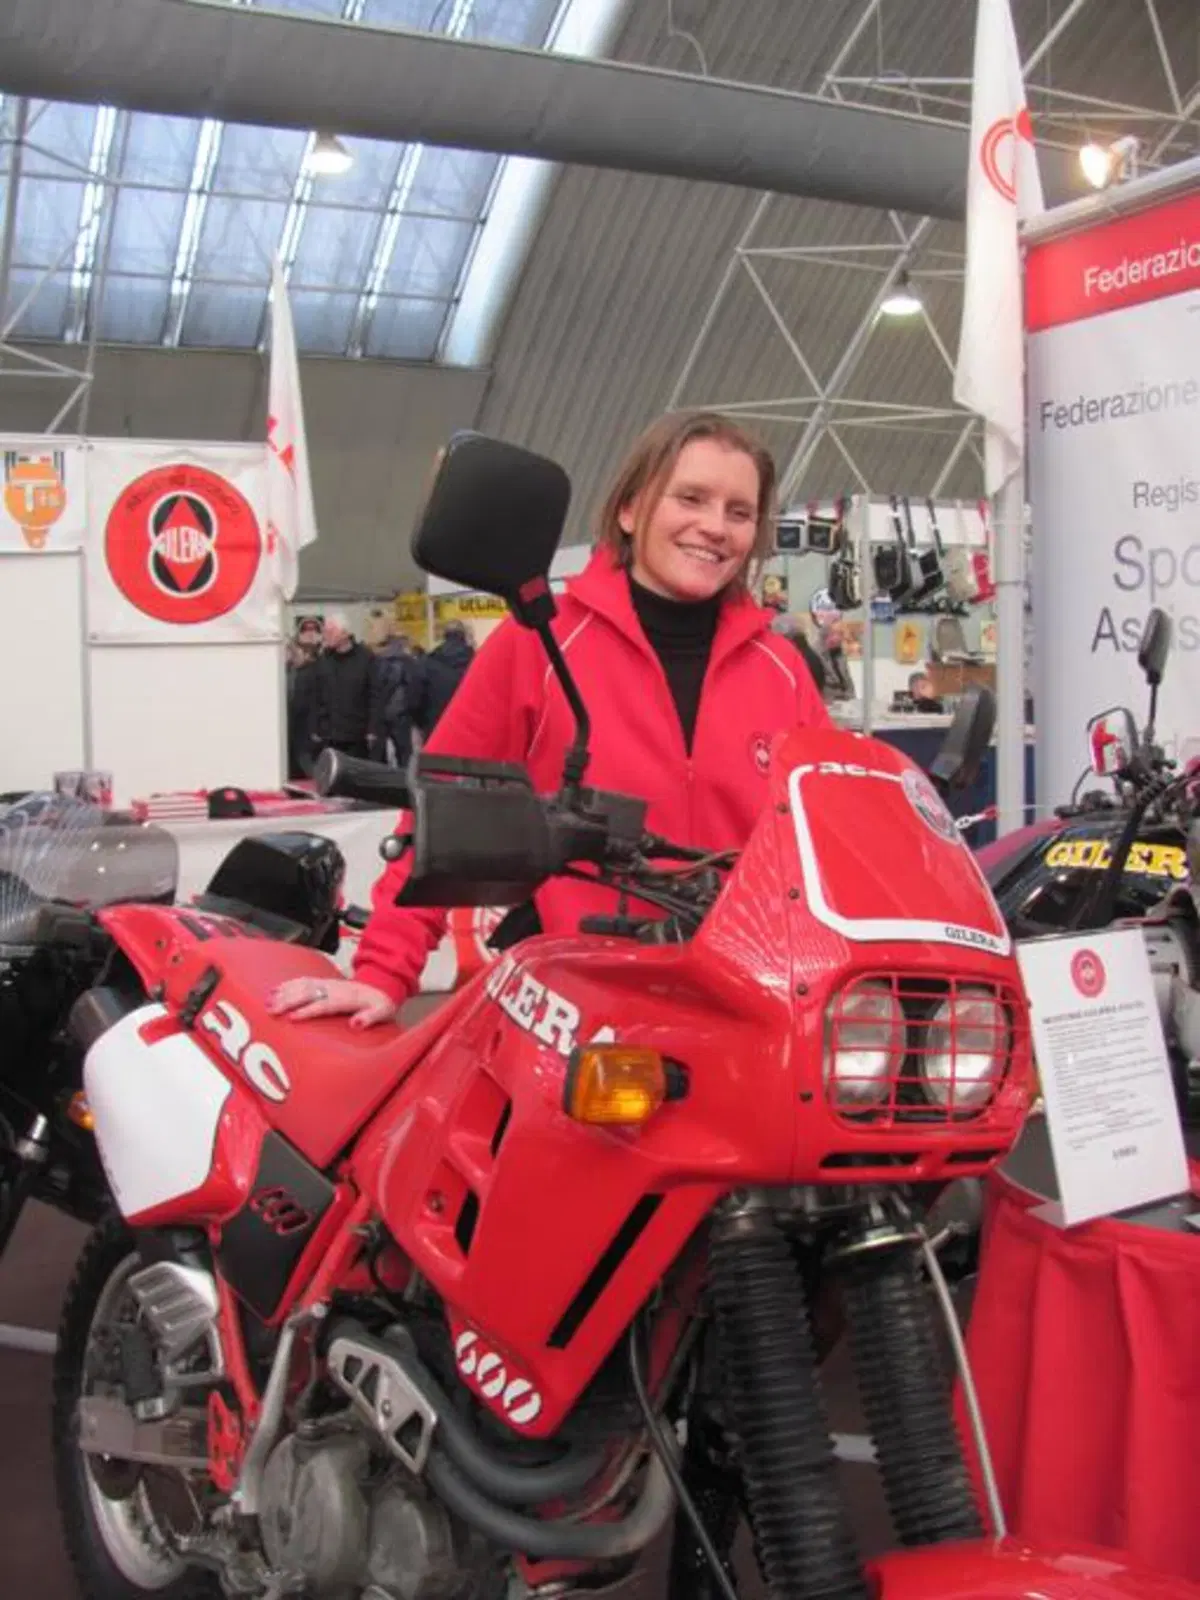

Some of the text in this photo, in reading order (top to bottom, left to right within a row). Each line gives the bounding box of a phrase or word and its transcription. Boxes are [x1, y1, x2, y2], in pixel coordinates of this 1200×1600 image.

[1083, 237, 1200, 297] Federazio
[1039, 380, 1198, 432] Federazione
[1133, 477, 1200, 512] Regis
[945, 925, 1000, 949] GILERA
